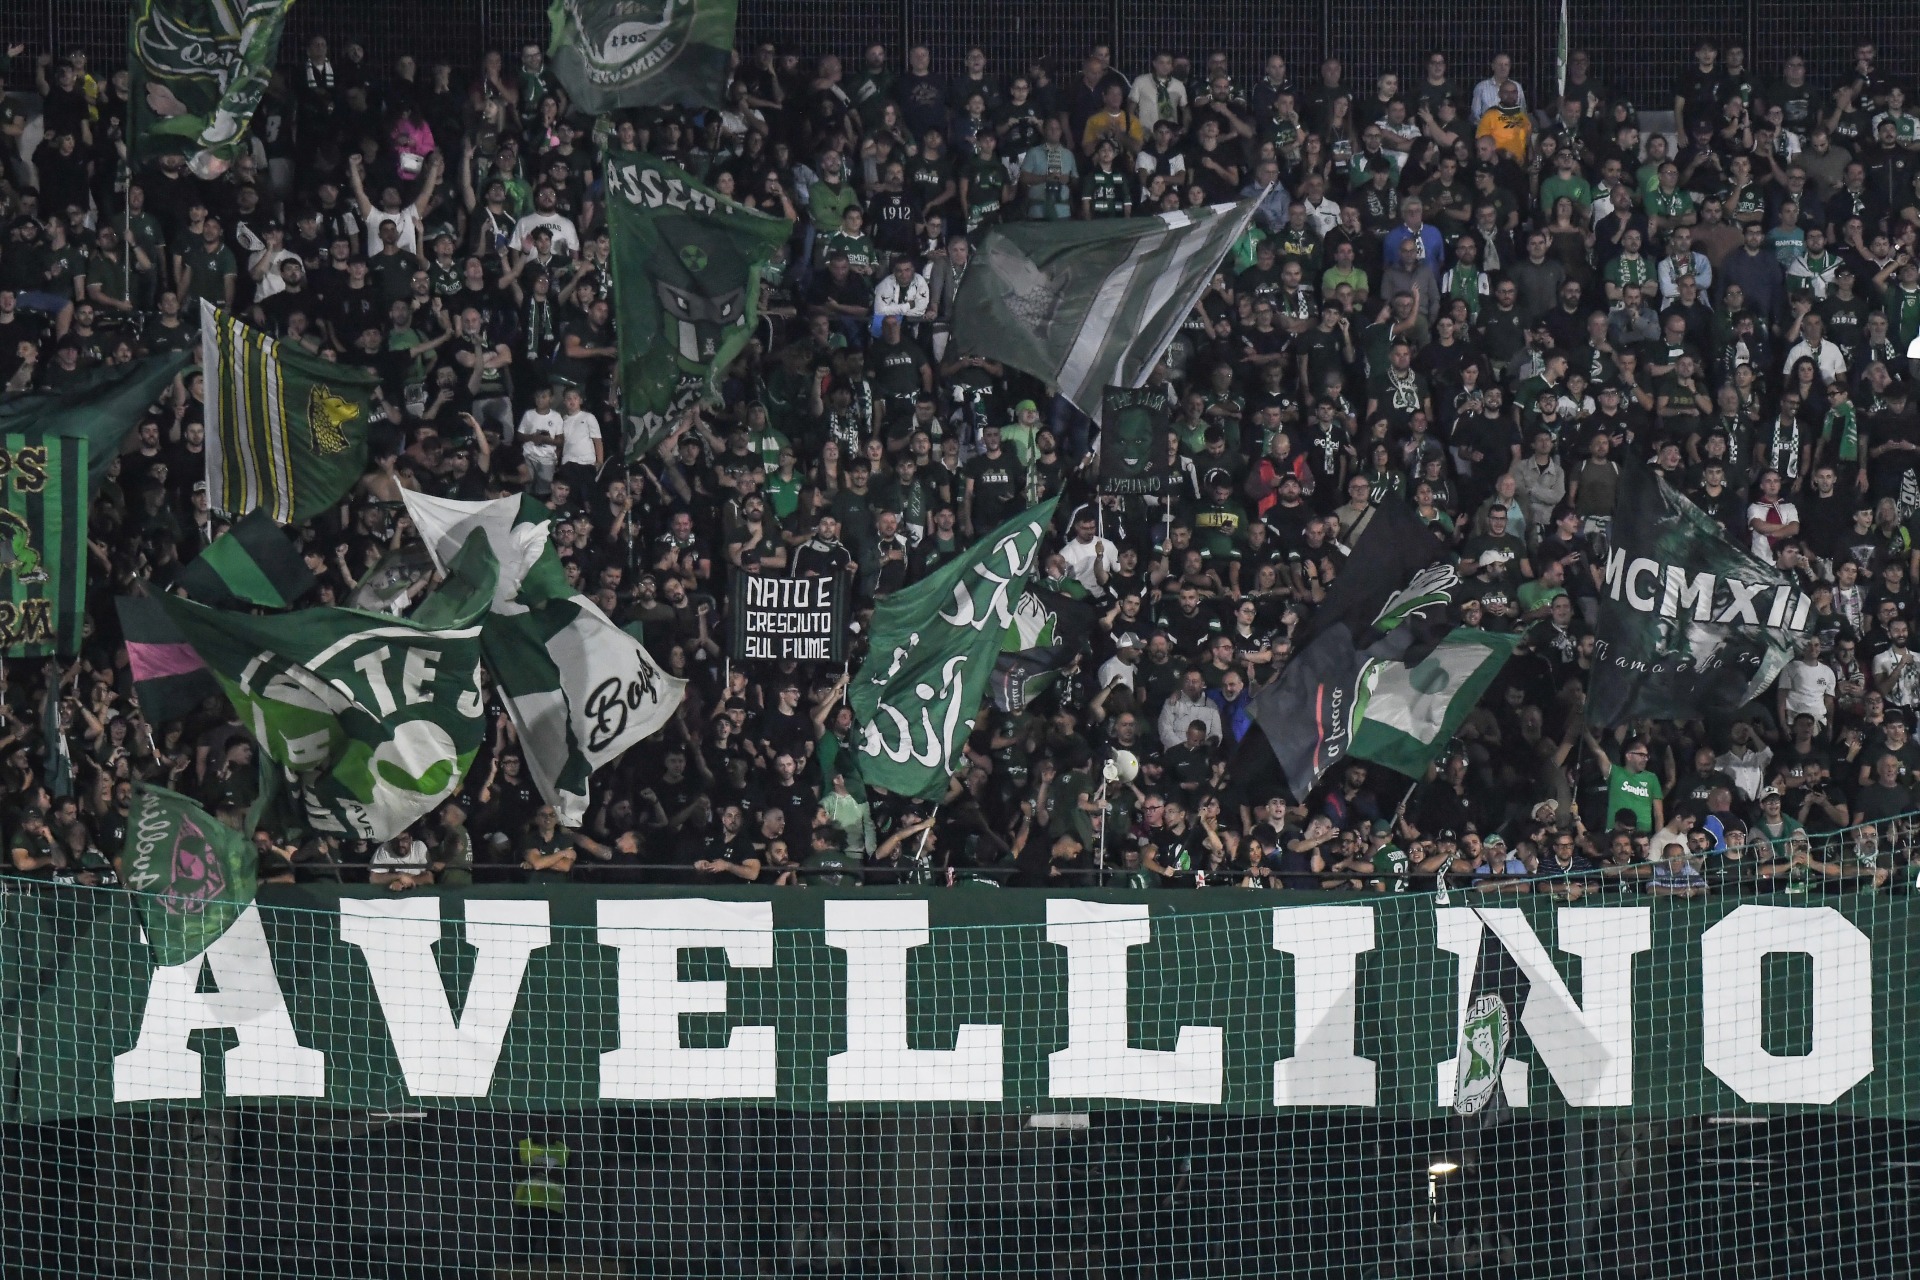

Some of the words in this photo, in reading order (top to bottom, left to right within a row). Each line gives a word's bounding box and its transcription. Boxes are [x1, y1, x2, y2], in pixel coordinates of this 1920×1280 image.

[883, 206, 911, 220] 1912
[746, 575, 810, 608] NATO
[816, 576, 833, 607] E
[1605, 544, 1812, 632] MCMXII
[746, 610, 831, 633] CRESCIUTO
[745, 635, 778, 659] SUL
[782, 637, 831, 659] FIUME
[1615, 656, 1665, 674] amo
[584, 648, 660, 752] Boys
[114, 897, 1875, 1106] AVELLINO
